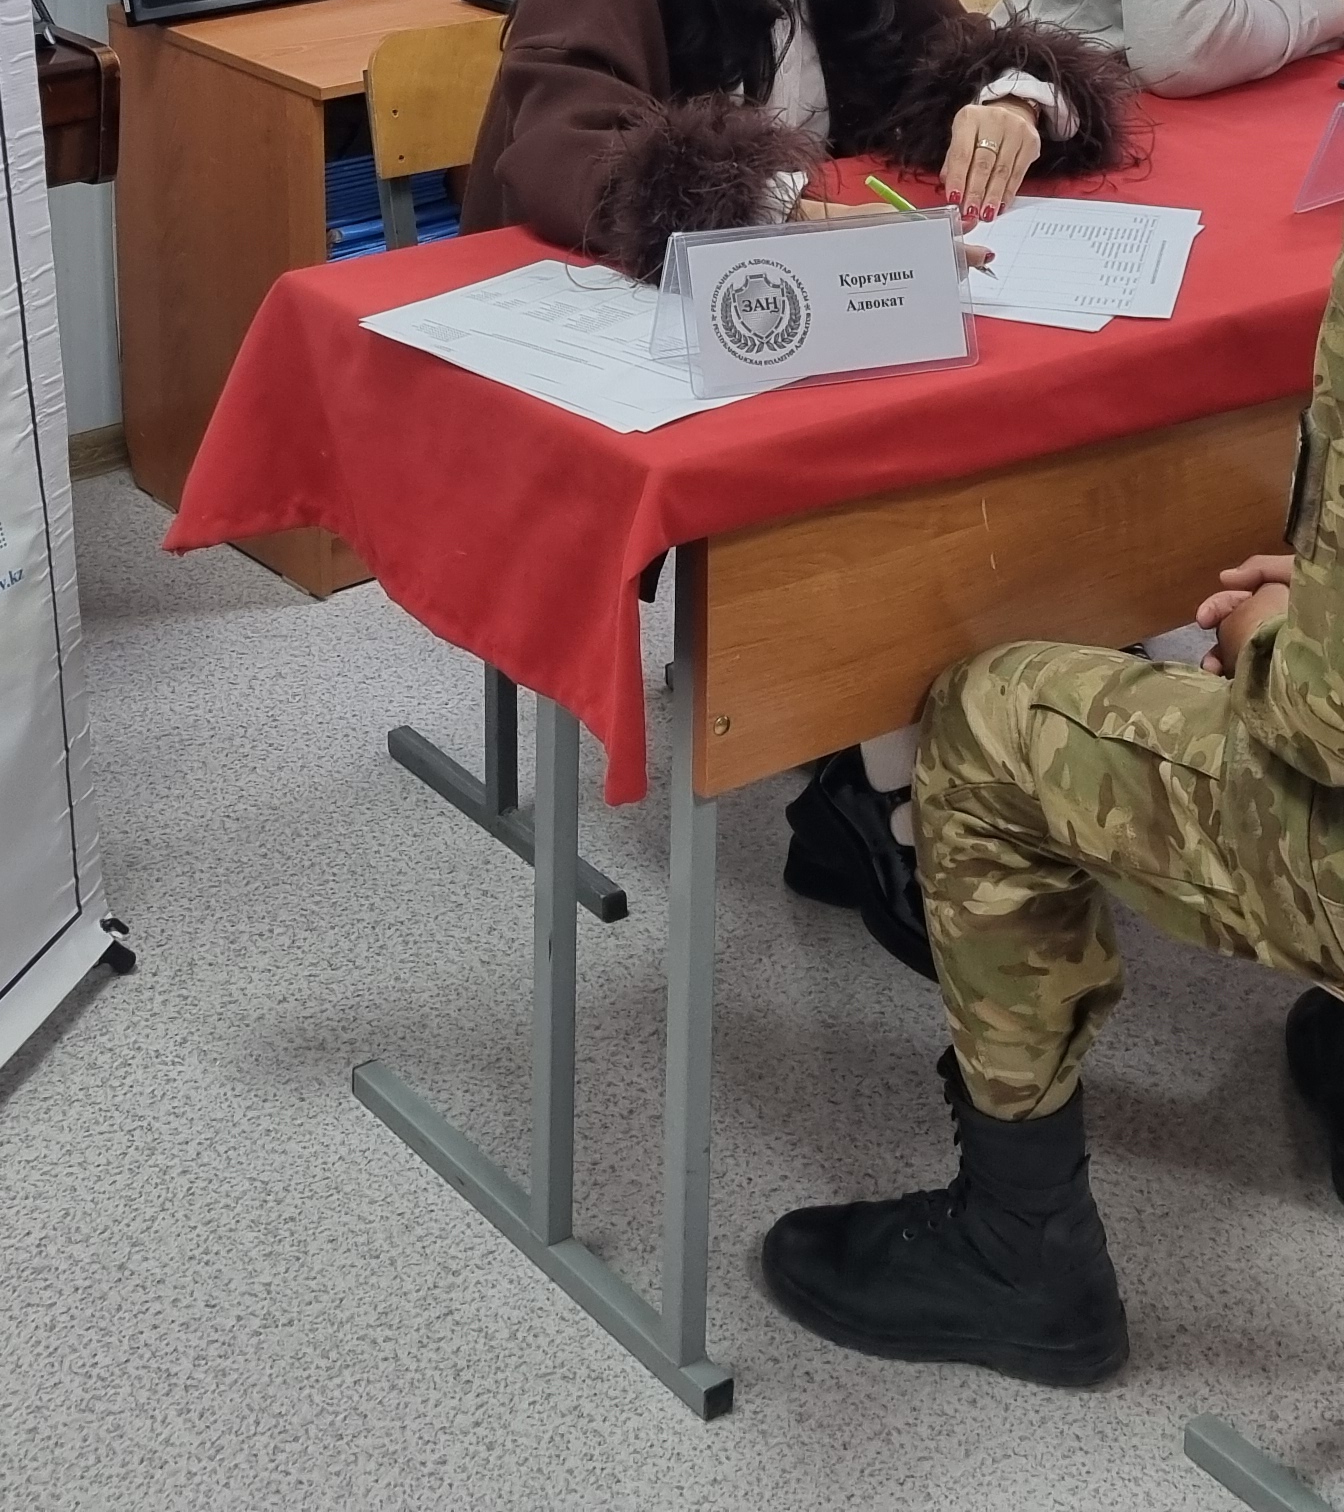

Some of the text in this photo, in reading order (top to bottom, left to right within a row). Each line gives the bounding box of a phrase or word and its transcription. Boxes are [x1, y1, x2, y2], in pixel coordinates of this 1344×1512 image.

[839, 270, 914, 288] Қорғаушы
[742, 296, 779, 314] ЗАҢ
[847, 296, 905, 312] Адвокат
